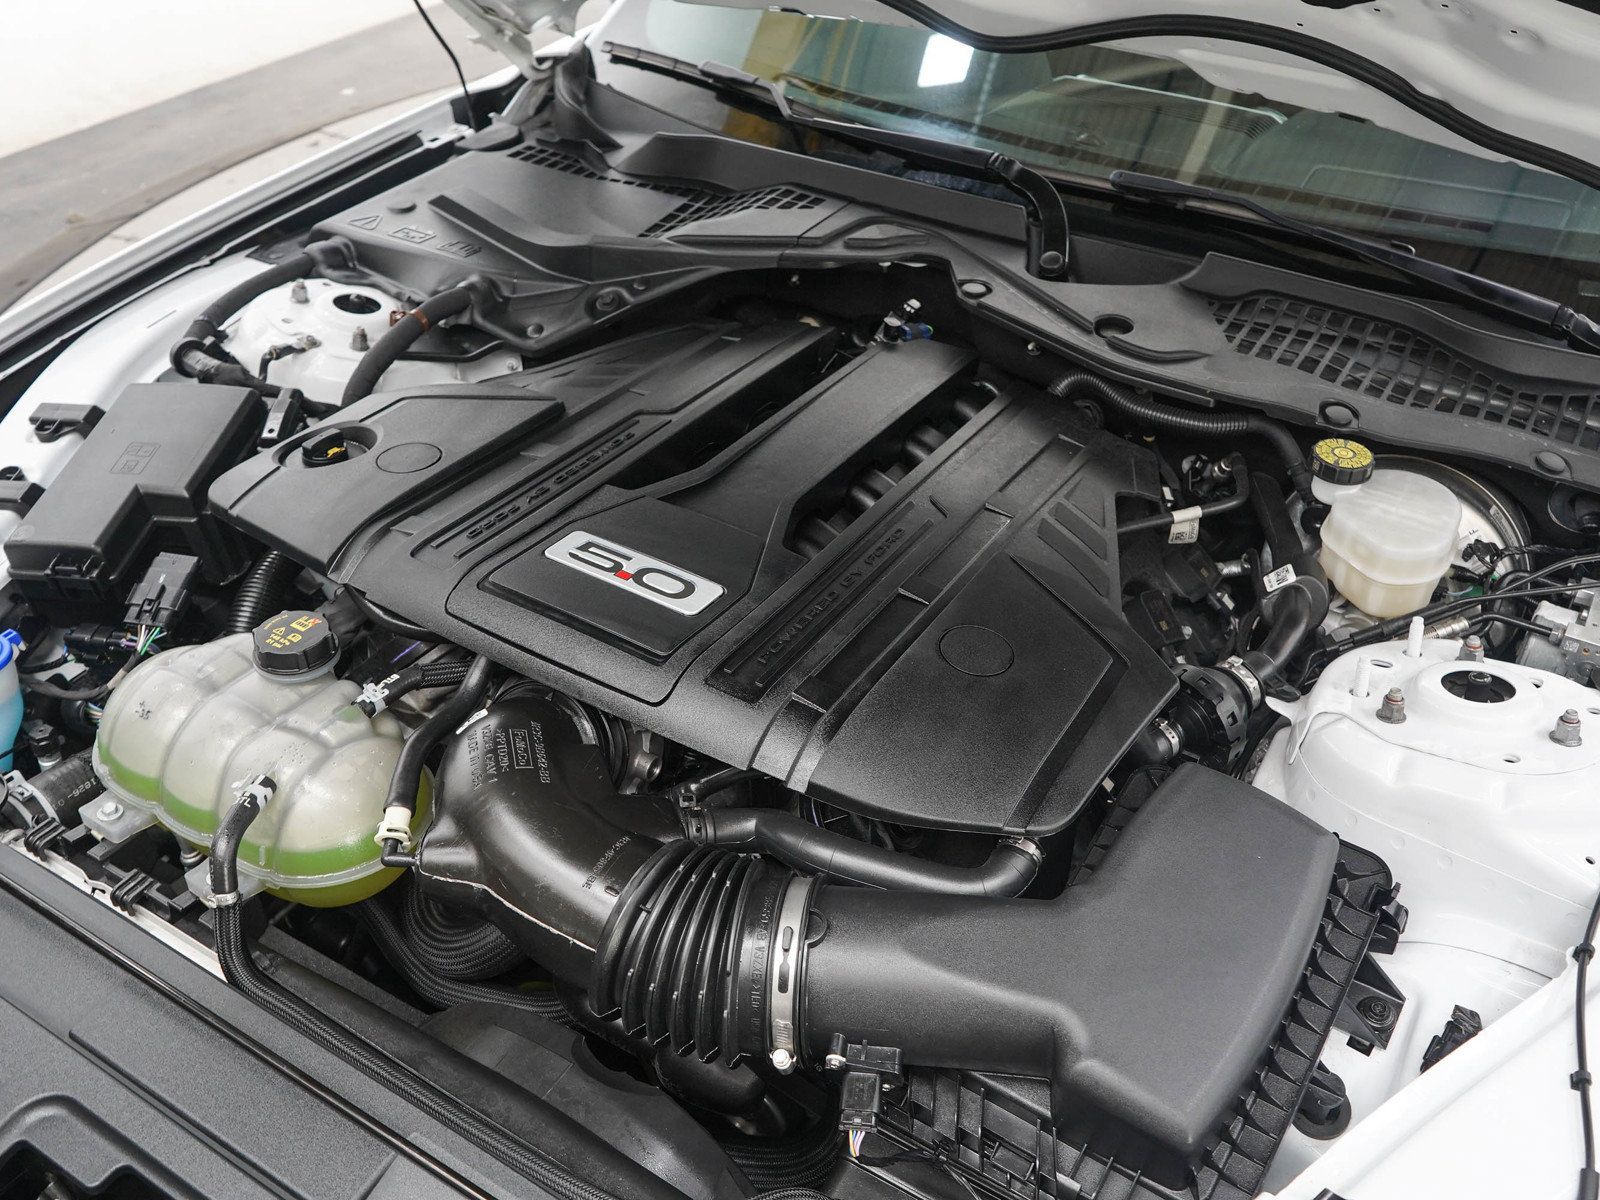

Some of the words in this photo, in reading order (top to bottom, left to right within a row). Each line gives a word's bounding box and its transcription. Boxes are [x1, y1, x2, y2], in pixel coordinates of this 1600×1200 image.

[553, 432, 635, 484] POWERED
[527, 485, 550, 505] BY
[466, 505, 520, 539] FORD
[567, 540, 698, 600] 5.0
[757, 590, 840, 664] POWERED
[840, 567, 865, 589] BY
[864, 527, 905, 567] FORD
[514, 730, 528, 766] FoMoCo
